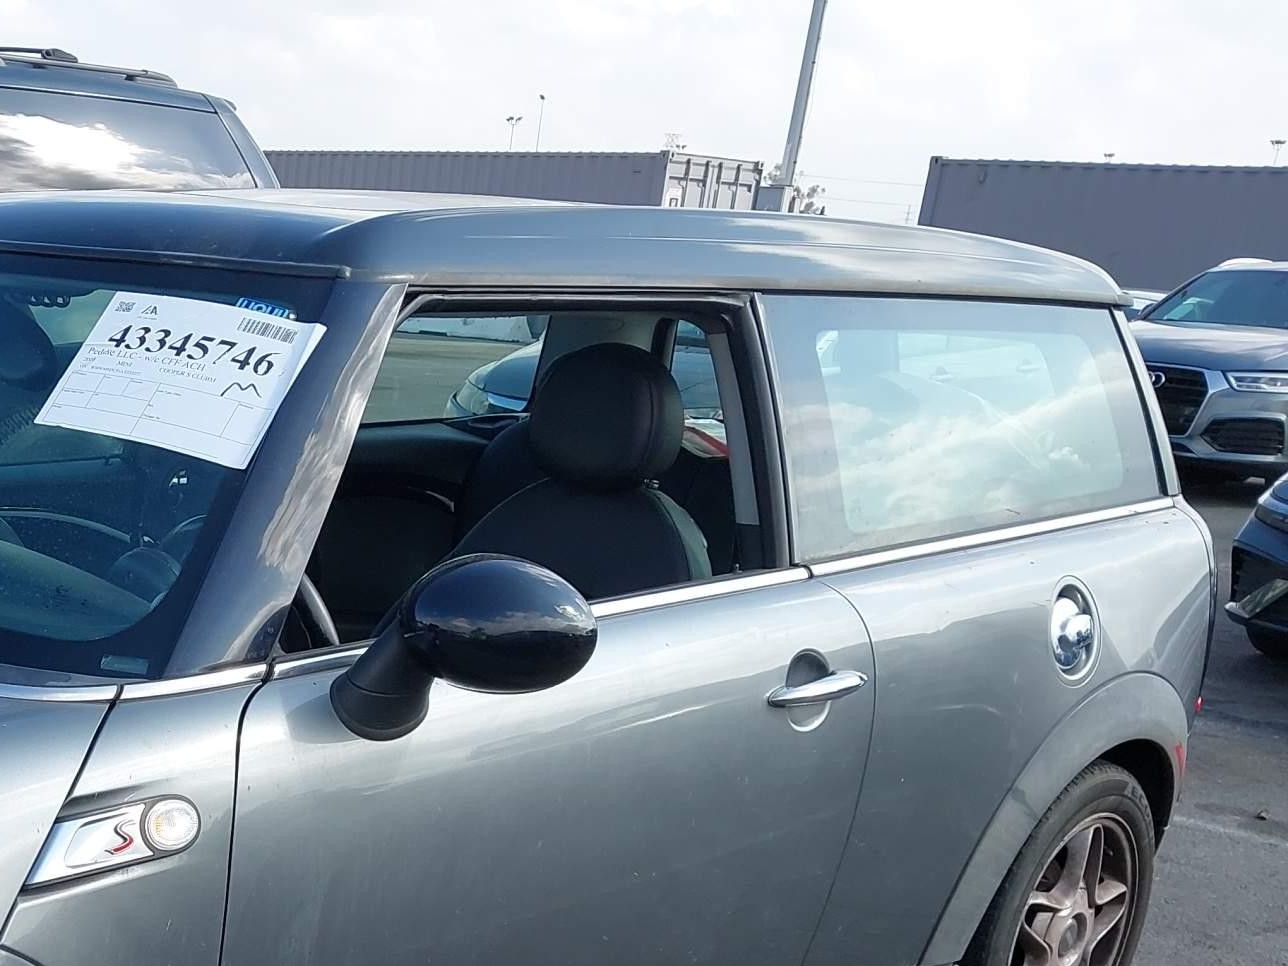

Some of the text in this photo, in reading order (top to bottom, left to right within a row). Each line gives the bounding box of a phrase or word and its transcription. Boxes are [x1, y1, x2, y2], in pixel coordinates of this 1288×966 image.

[108, 324, 283, 377] 43345746
[117, 350, 138, 360] LLC
[104, 819, 137, 855] S
